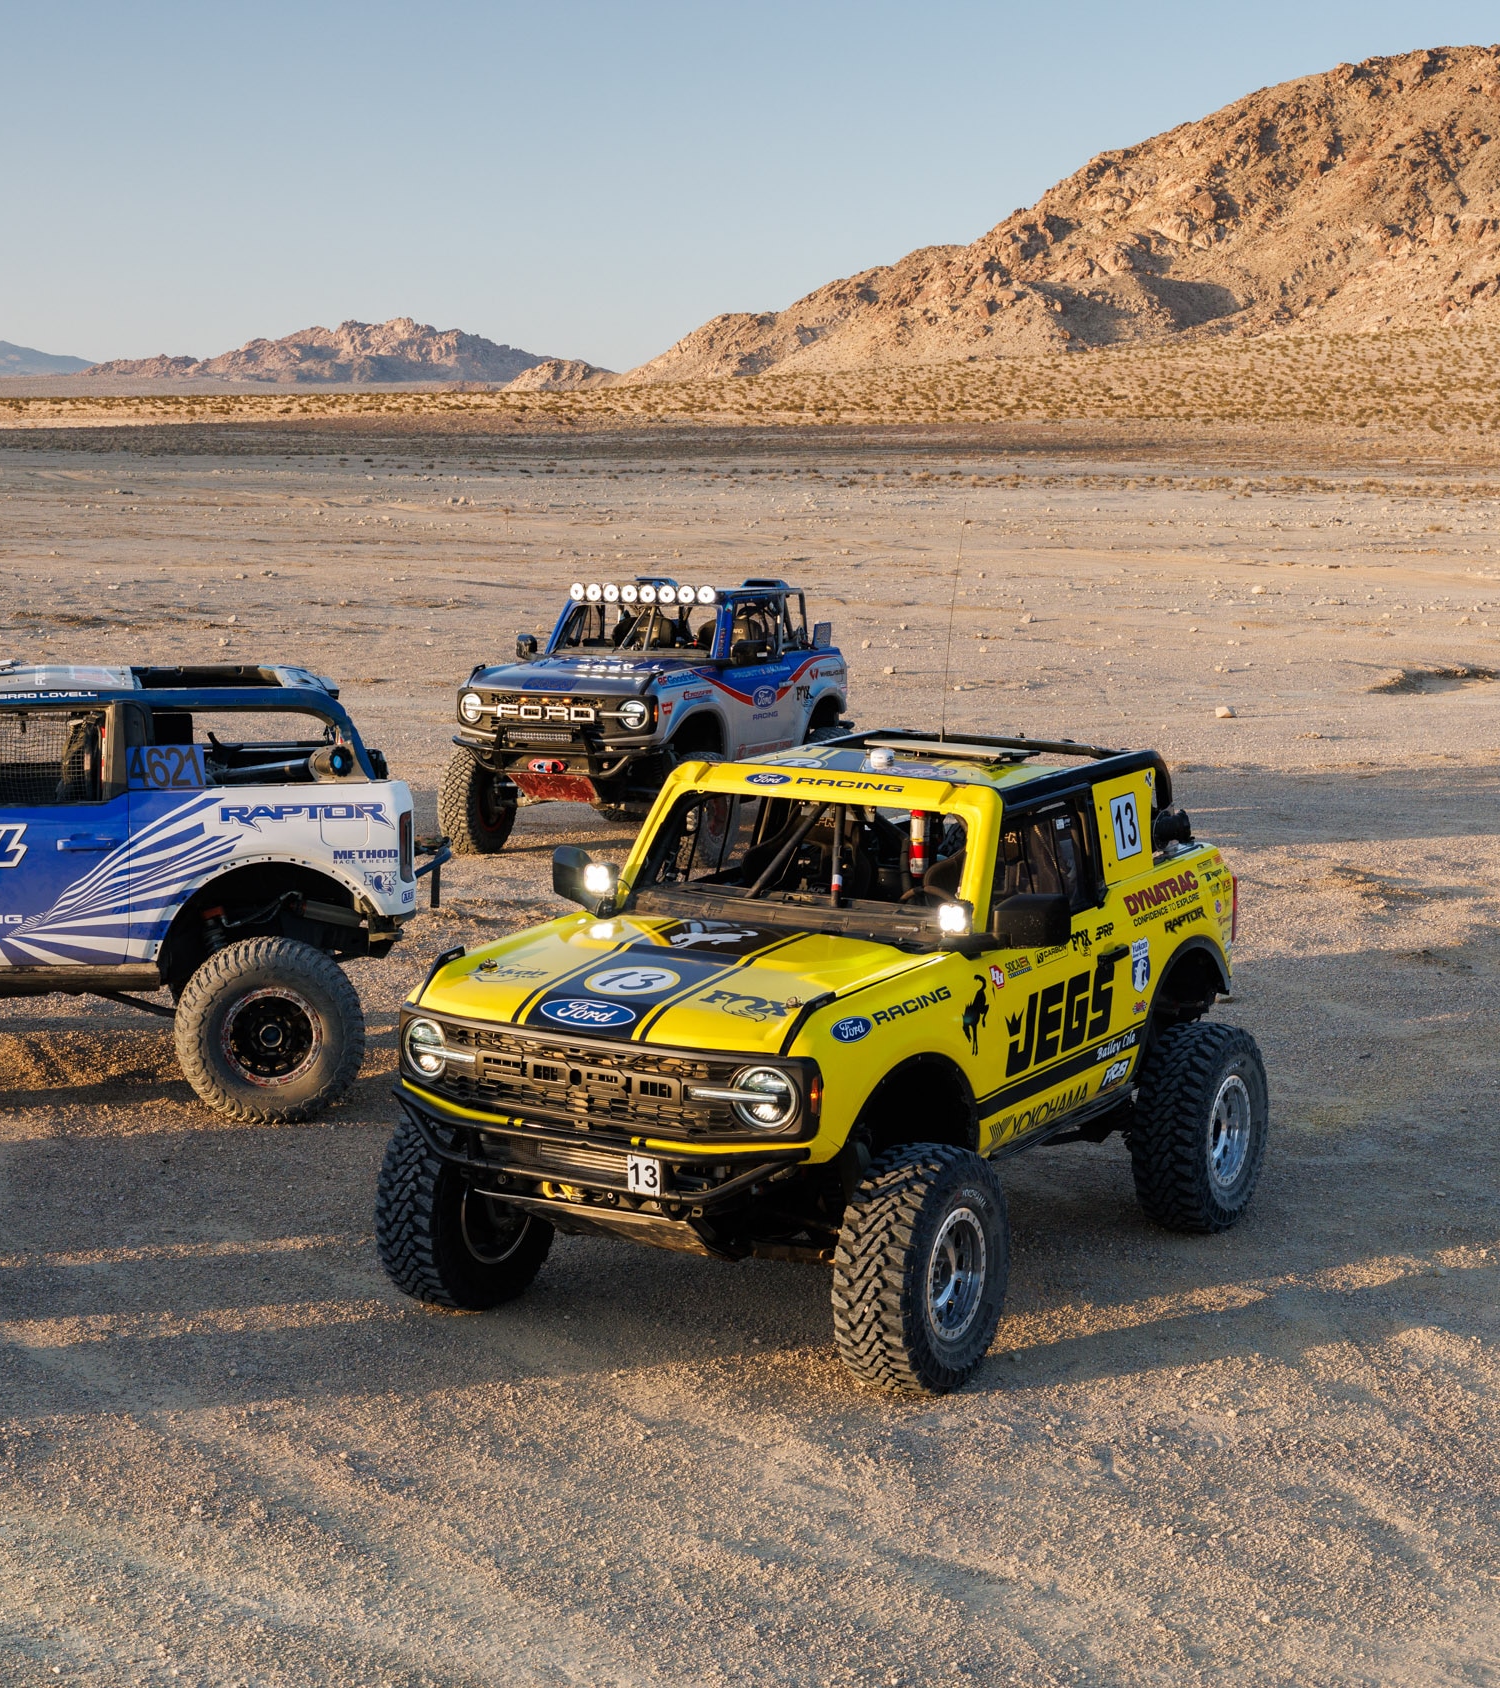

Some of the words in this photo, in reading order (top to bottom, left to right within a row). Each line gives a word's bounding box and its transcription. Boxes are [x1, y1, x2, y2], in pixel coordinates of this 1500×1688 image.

[496, 703, 596, 722] FORD
[752, 710, 779, 721] RACING
[129, 746, 202, 787] 4621
[753, 773, 782, 784] Ford
[795, 777, 905, 793] RACING
[218, 802, 396, 831] RAPTOR
[1114, 800, 1138, 851] 13
[333, 849, 398, 859] METHOD
[363, 870, 397, 896] FOX
[1123, 870, 1199, 917] DYNATRAC
[1133, 906, 1169, 927] CONFIDENCE
[1169, 902, 1177, 911] TO
[1176, 892, 1200, 908] EXPLORE
[1164, 905, 1208, 934] RAPTOR
[1044, 944, 1067, 958] CARBON
[1070, 929, 1092, 953] FOX
[1132, 940, 1148, 953] Yukon
[599, 971, 667, 990] 13
[557, 1001, 612, 1023] Ford
[699, 989, 788, 1022] FOX
[839, 1020, 865, 1039] Ford
[872, 985, 952, 1026] RACING
[1005, 959, 1115, 1078] JEGS
[1096, 1039, 1122, 1061] Bailey
[1122, 1029, 1136, 1048] Cole
[476, 1049, 682, 1106] FORD
[1011, 1081, 1089, 1138] YOKOHAMA
[629, 1162, 658, 1188] 13
